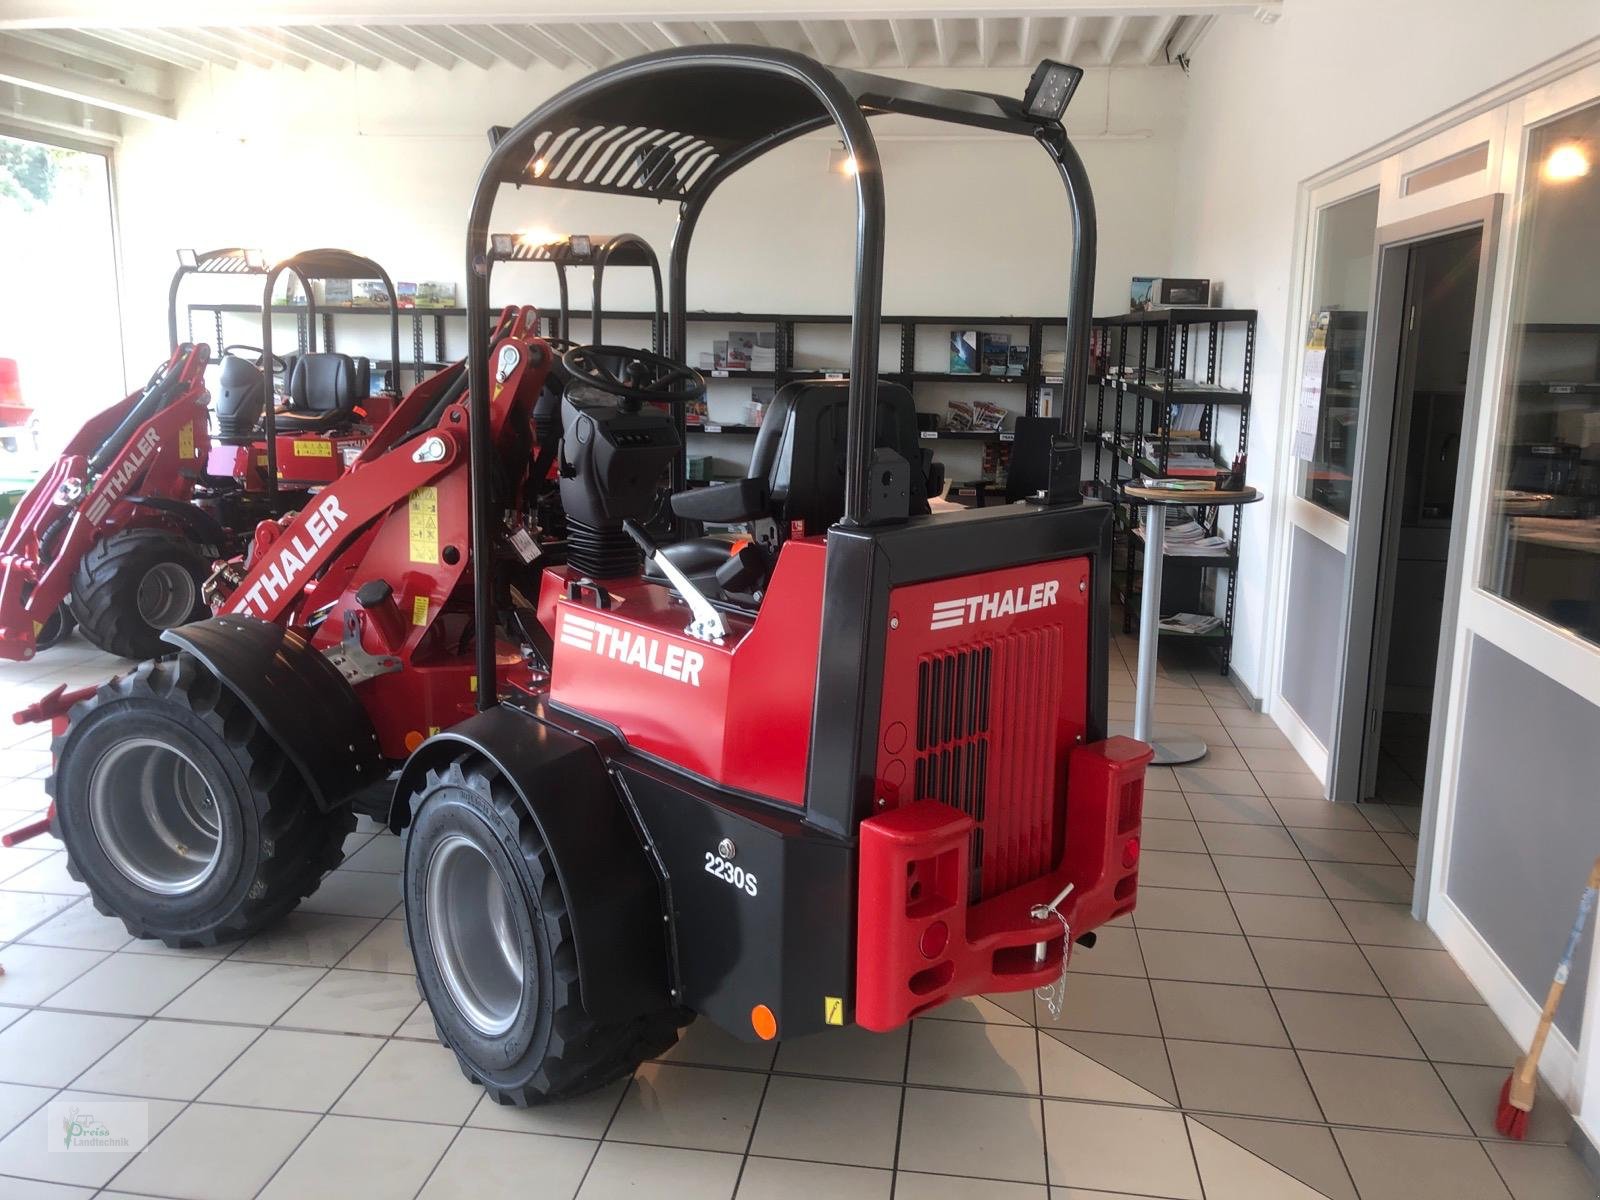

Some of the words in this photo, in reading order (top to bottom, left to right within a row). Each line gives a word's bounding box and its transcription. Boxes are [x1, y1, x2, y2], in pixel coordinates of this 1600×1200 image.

[103, 427, 160, 500] THALER
[245, 495, 348, 614] THALER
[965, 580, 1060, 624] THALER
[594, 622, 704, 687] THALER
[705, 851, 758, 897] 2230S
